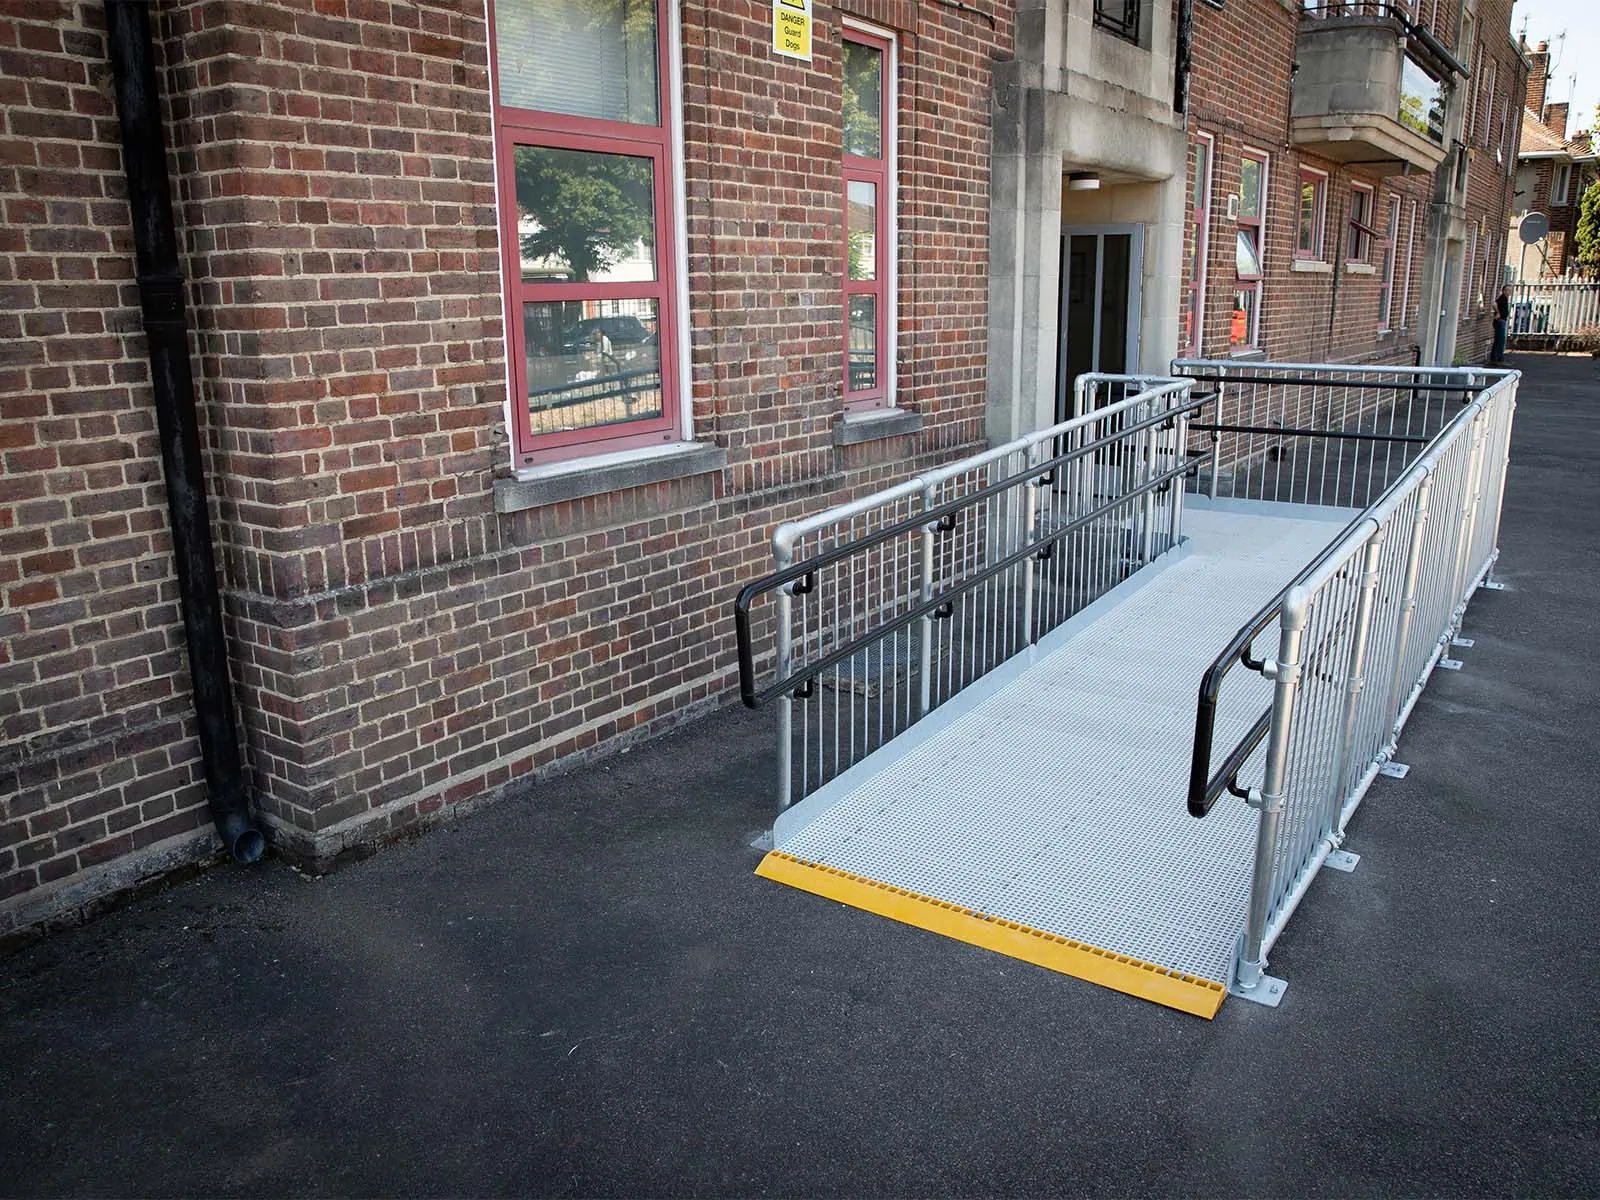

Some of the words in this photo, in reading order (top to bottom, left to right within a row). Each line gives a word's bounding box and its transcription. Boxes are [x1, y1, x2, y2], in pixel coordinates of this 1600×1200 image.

[780, 12, 805, 26] DANGER
[784, 26, 801, 37] Guard
[785, 39, 800, 51] Dogs
